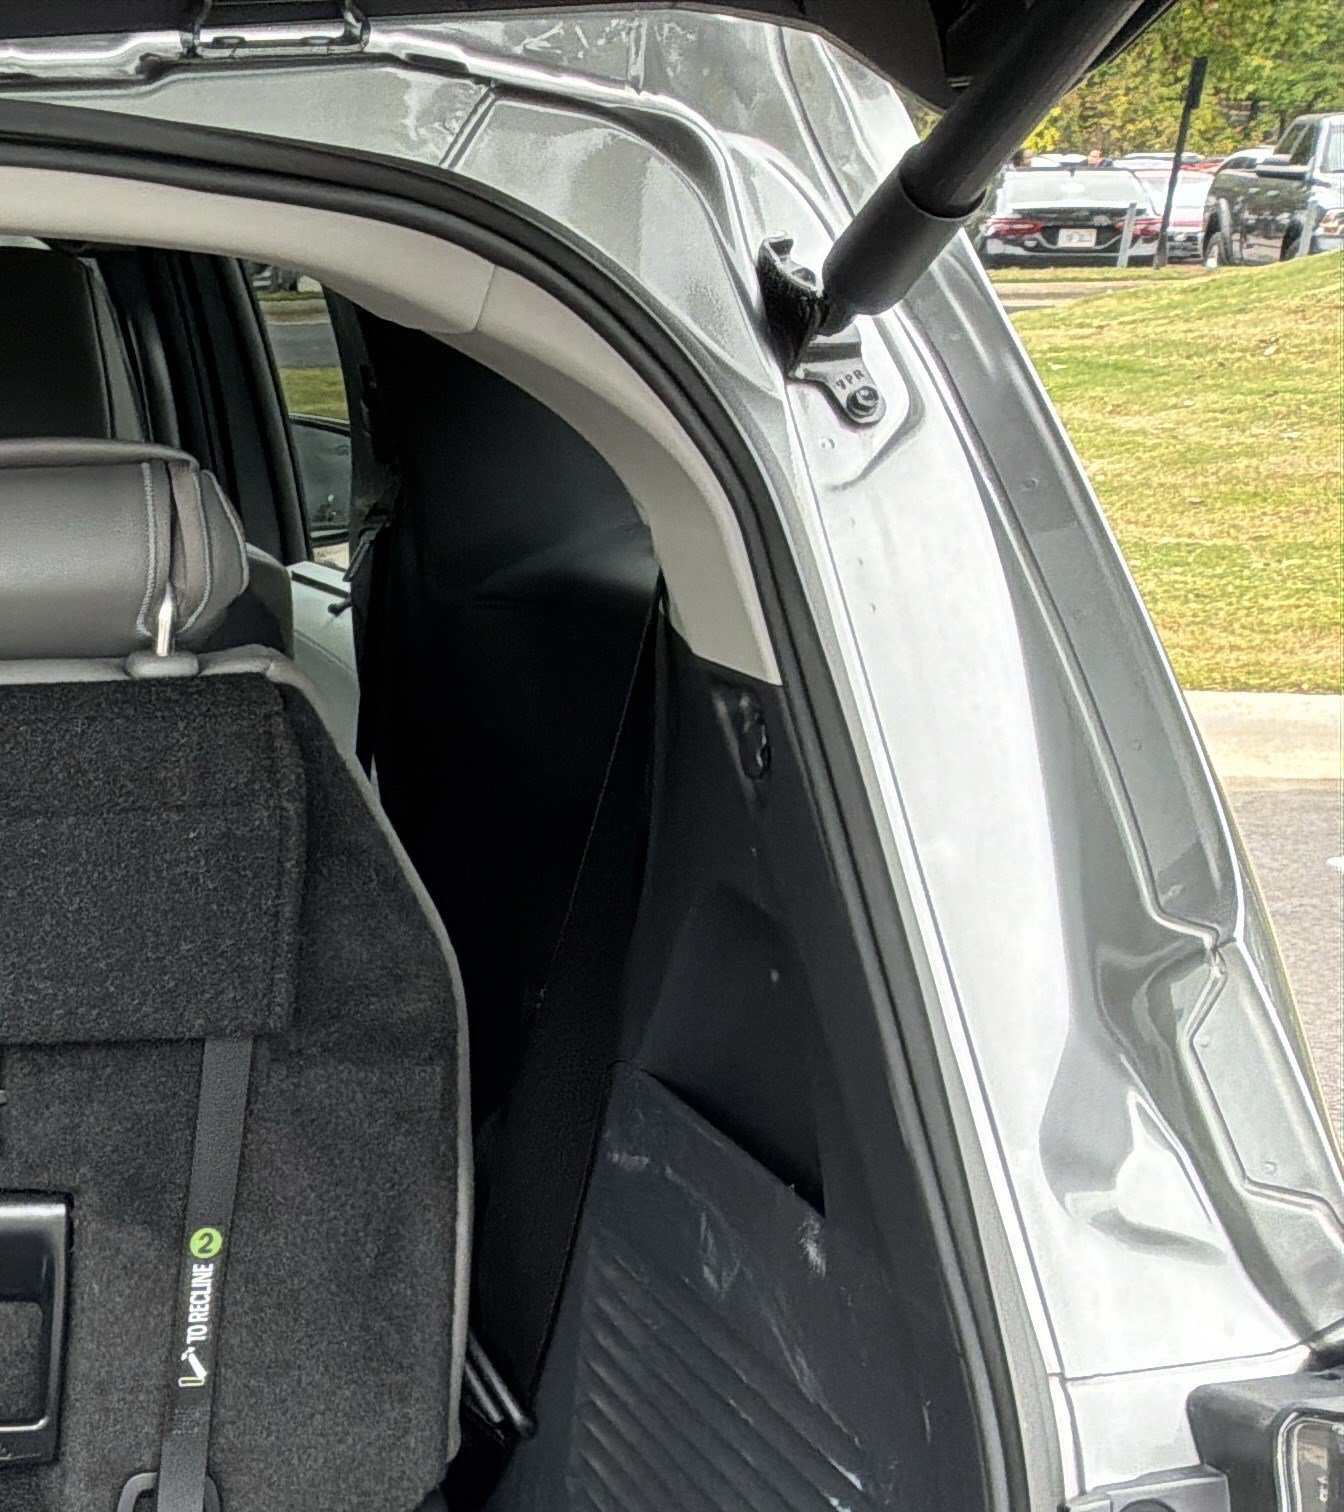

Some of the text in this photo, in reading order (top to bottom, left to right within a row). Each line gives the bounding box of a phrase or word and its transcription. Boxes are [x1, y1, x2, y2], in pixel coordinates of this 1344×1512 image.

[197, 1232, 214, 1255] 2
[186, 1263, 214, 1344] TO RECLINE
